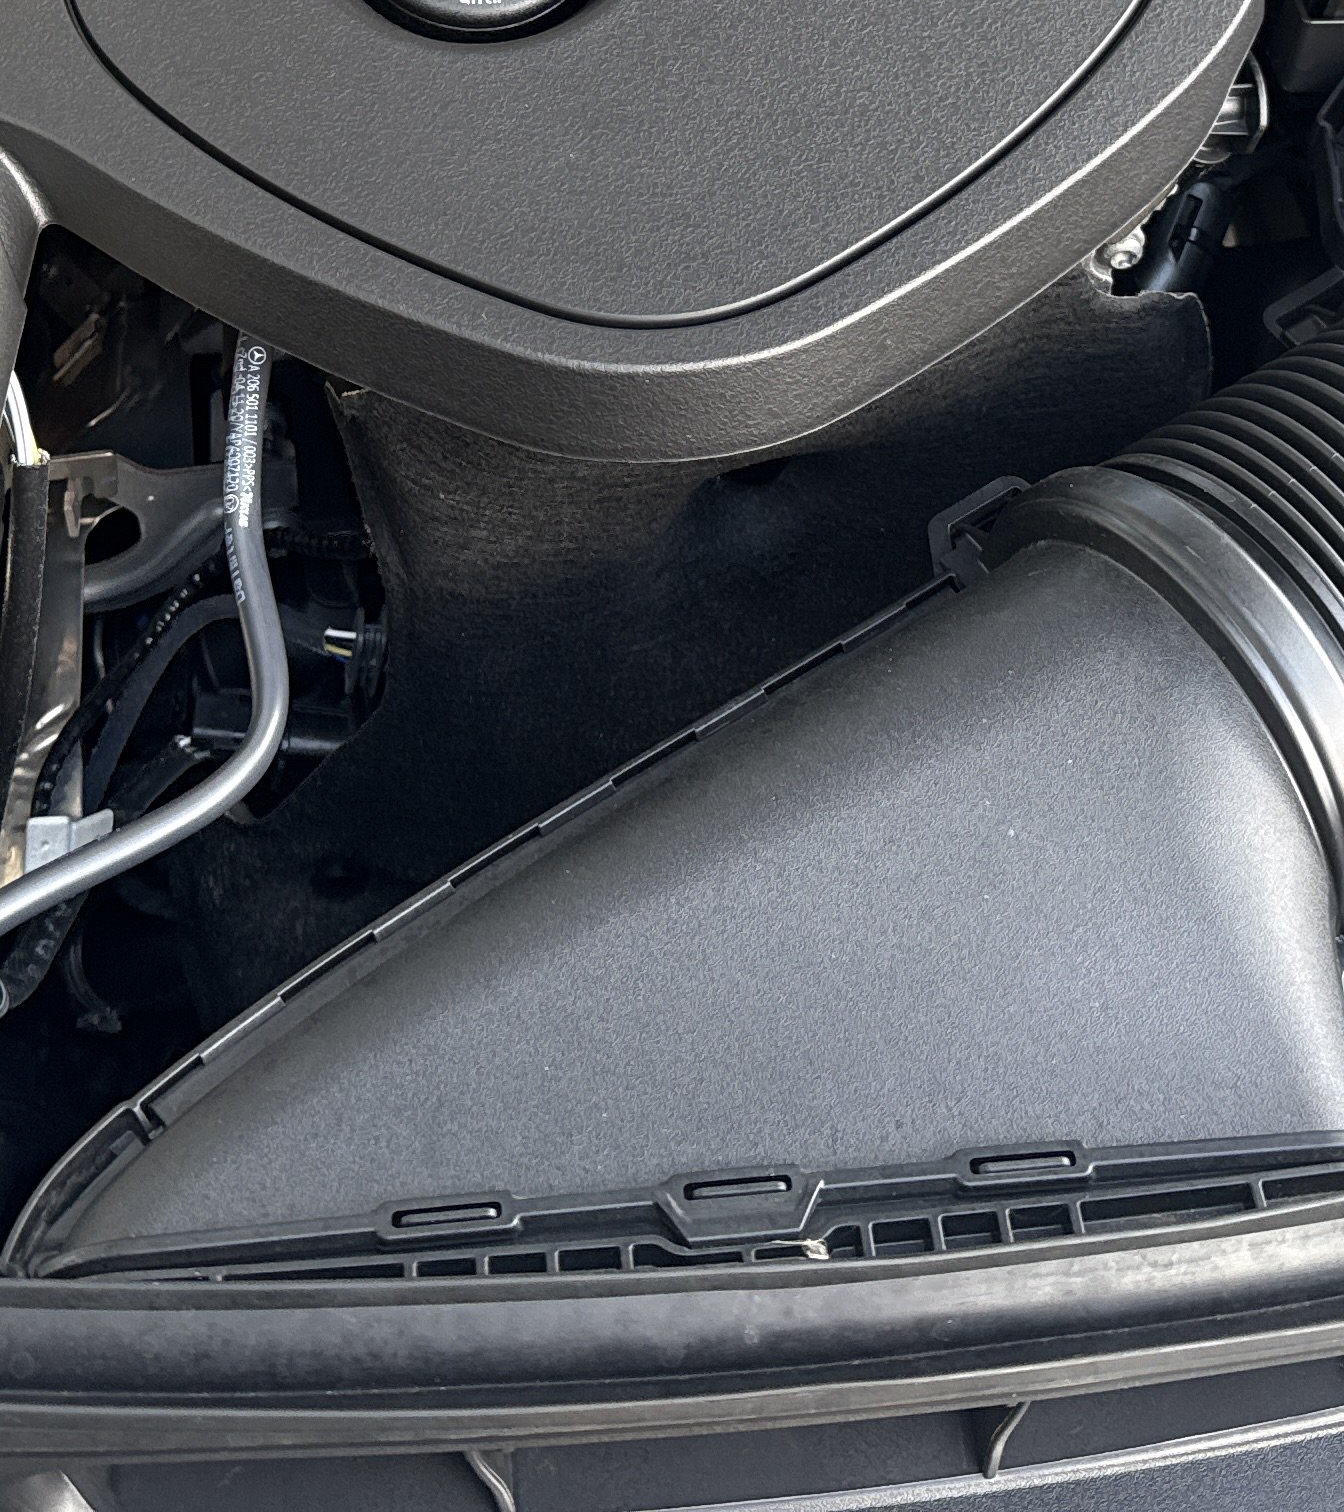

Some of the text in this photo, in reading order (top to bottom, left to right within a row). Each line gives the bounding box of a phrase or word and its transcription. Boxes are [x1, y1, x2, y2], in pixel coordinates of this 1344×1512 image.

[247, 364, 261, 372] A
[246, 373, 261, 392] 206
[245, 393, 260, 411] 501
